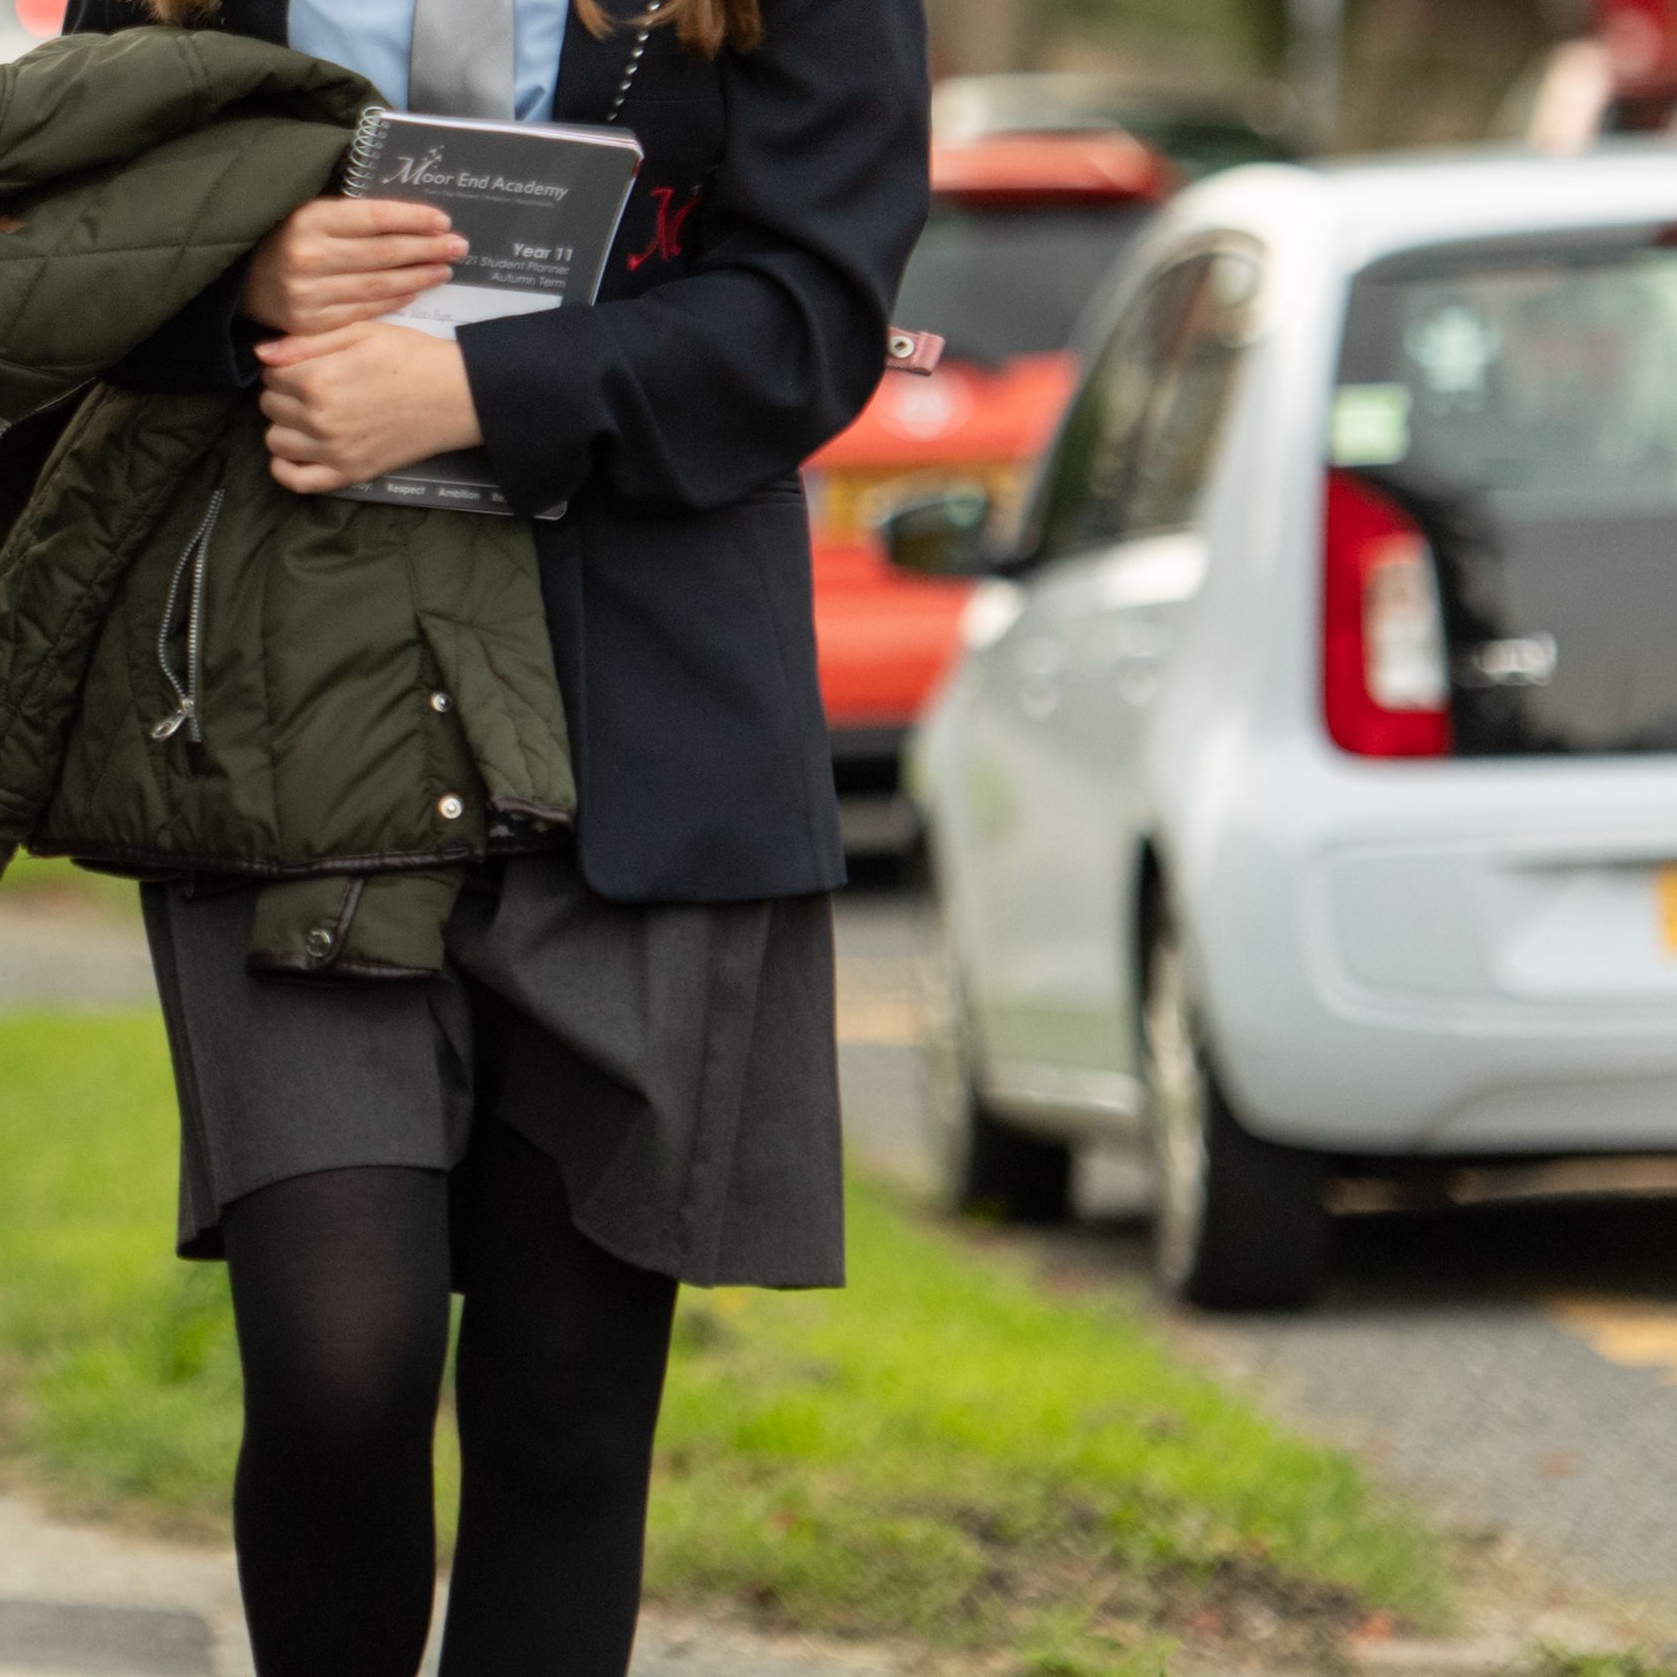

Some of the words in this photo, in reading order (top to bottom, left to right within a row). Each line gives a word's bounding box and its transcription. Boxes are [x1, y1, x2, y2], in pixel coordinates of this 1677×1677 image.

[382, 156, 454, 185] Moor
[457, 172, 490, 189] End
[491, 177, 569, 201] Academy
[512, 242, 552, 259] Year
[556, 247, 574, 262] 11
[480, 256, 525, 271] Student
[527, 261, 571, 275] Planner
[491, 273, 536, 286] Autumn
[539, 276, 566, 288] Term
[387, 483, 425, 496] Respect
[438, 488, 480, 501] Ambition
